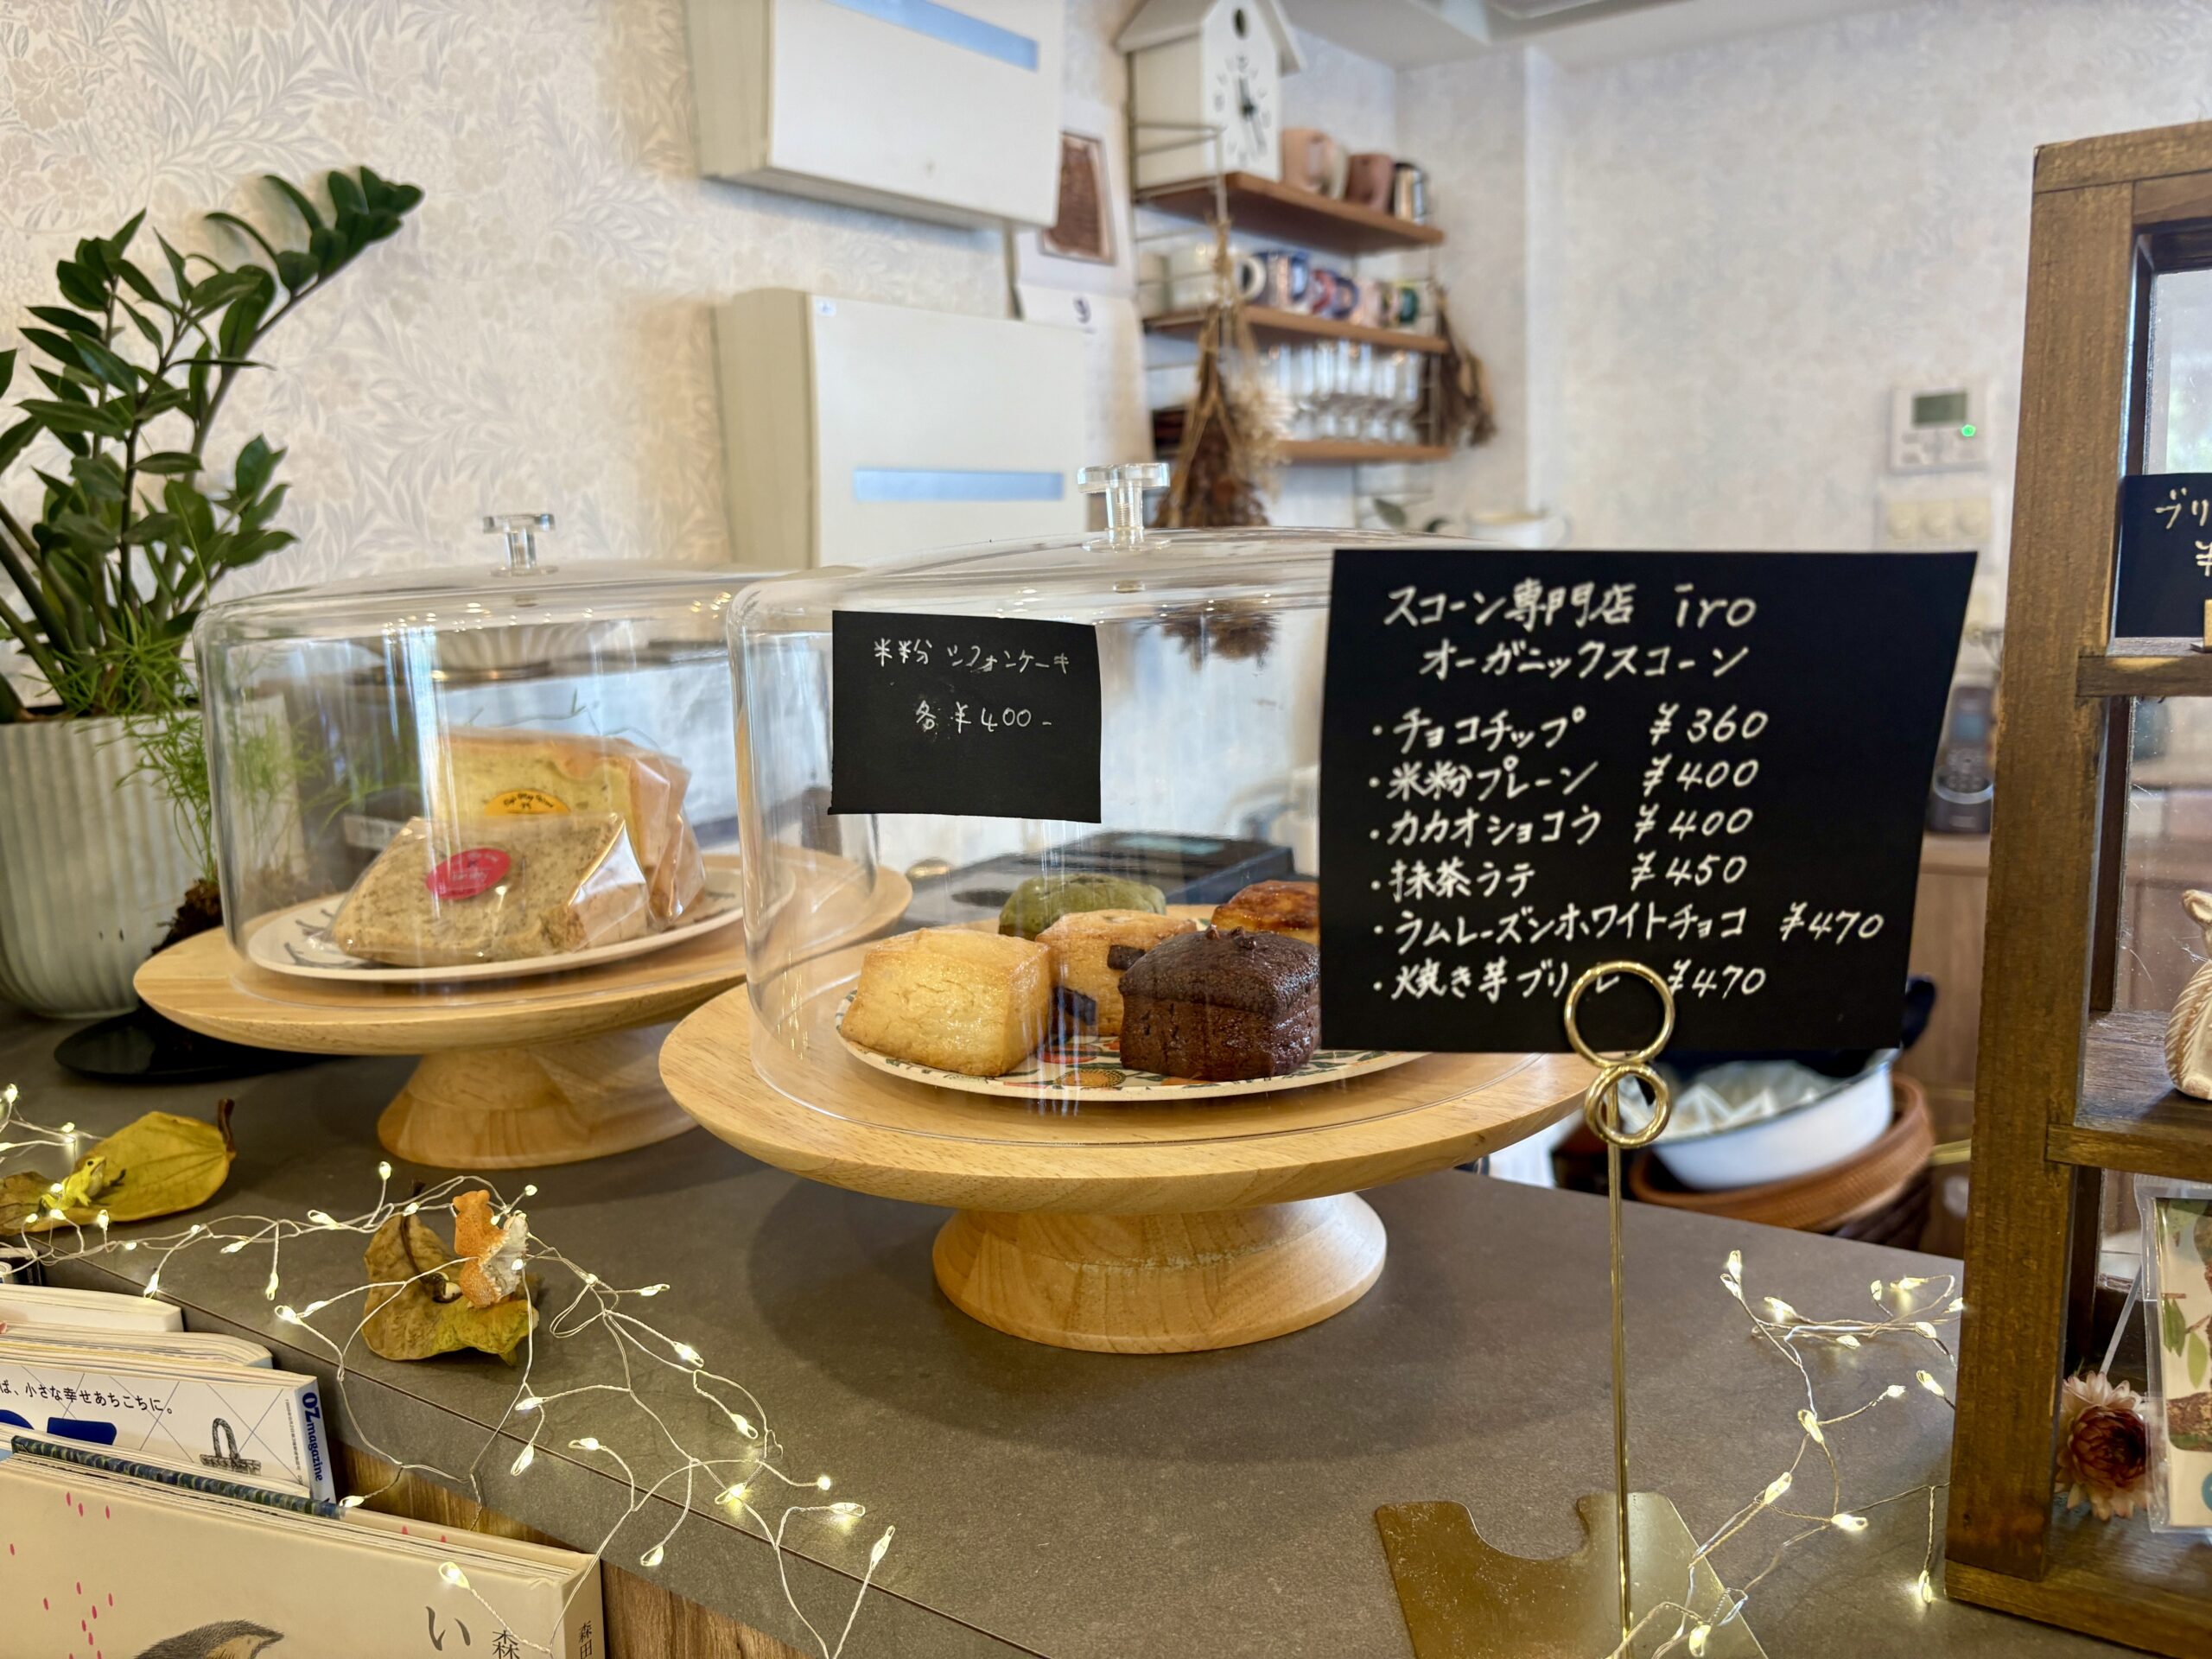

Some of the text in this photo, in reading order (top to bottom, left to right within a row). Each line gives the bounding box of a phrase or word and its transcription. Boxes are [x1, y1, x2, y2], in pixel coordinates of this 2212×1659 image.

[1383, 577, 1757, 632] スコーン専門店 iro
[1419, 638, 1750, 681] オーガニックスコーン
[1393, 702, 1770, 754] チョコチップ ¥360
[1386, 753, 1759, 802] 米粉プレーン ¥400
[1633, 802, 1754, 843] ¥400
[1388, 850, 1748, 903] 抹茶ラテ ¥450
[1395, 901, 1885, 955] ラムレーズンホワイトチョコ ¥470
[1390, 956, 1767, 1004] 焼き芋ブリレ ¥470
[426, 1605, 472, 1651] い
